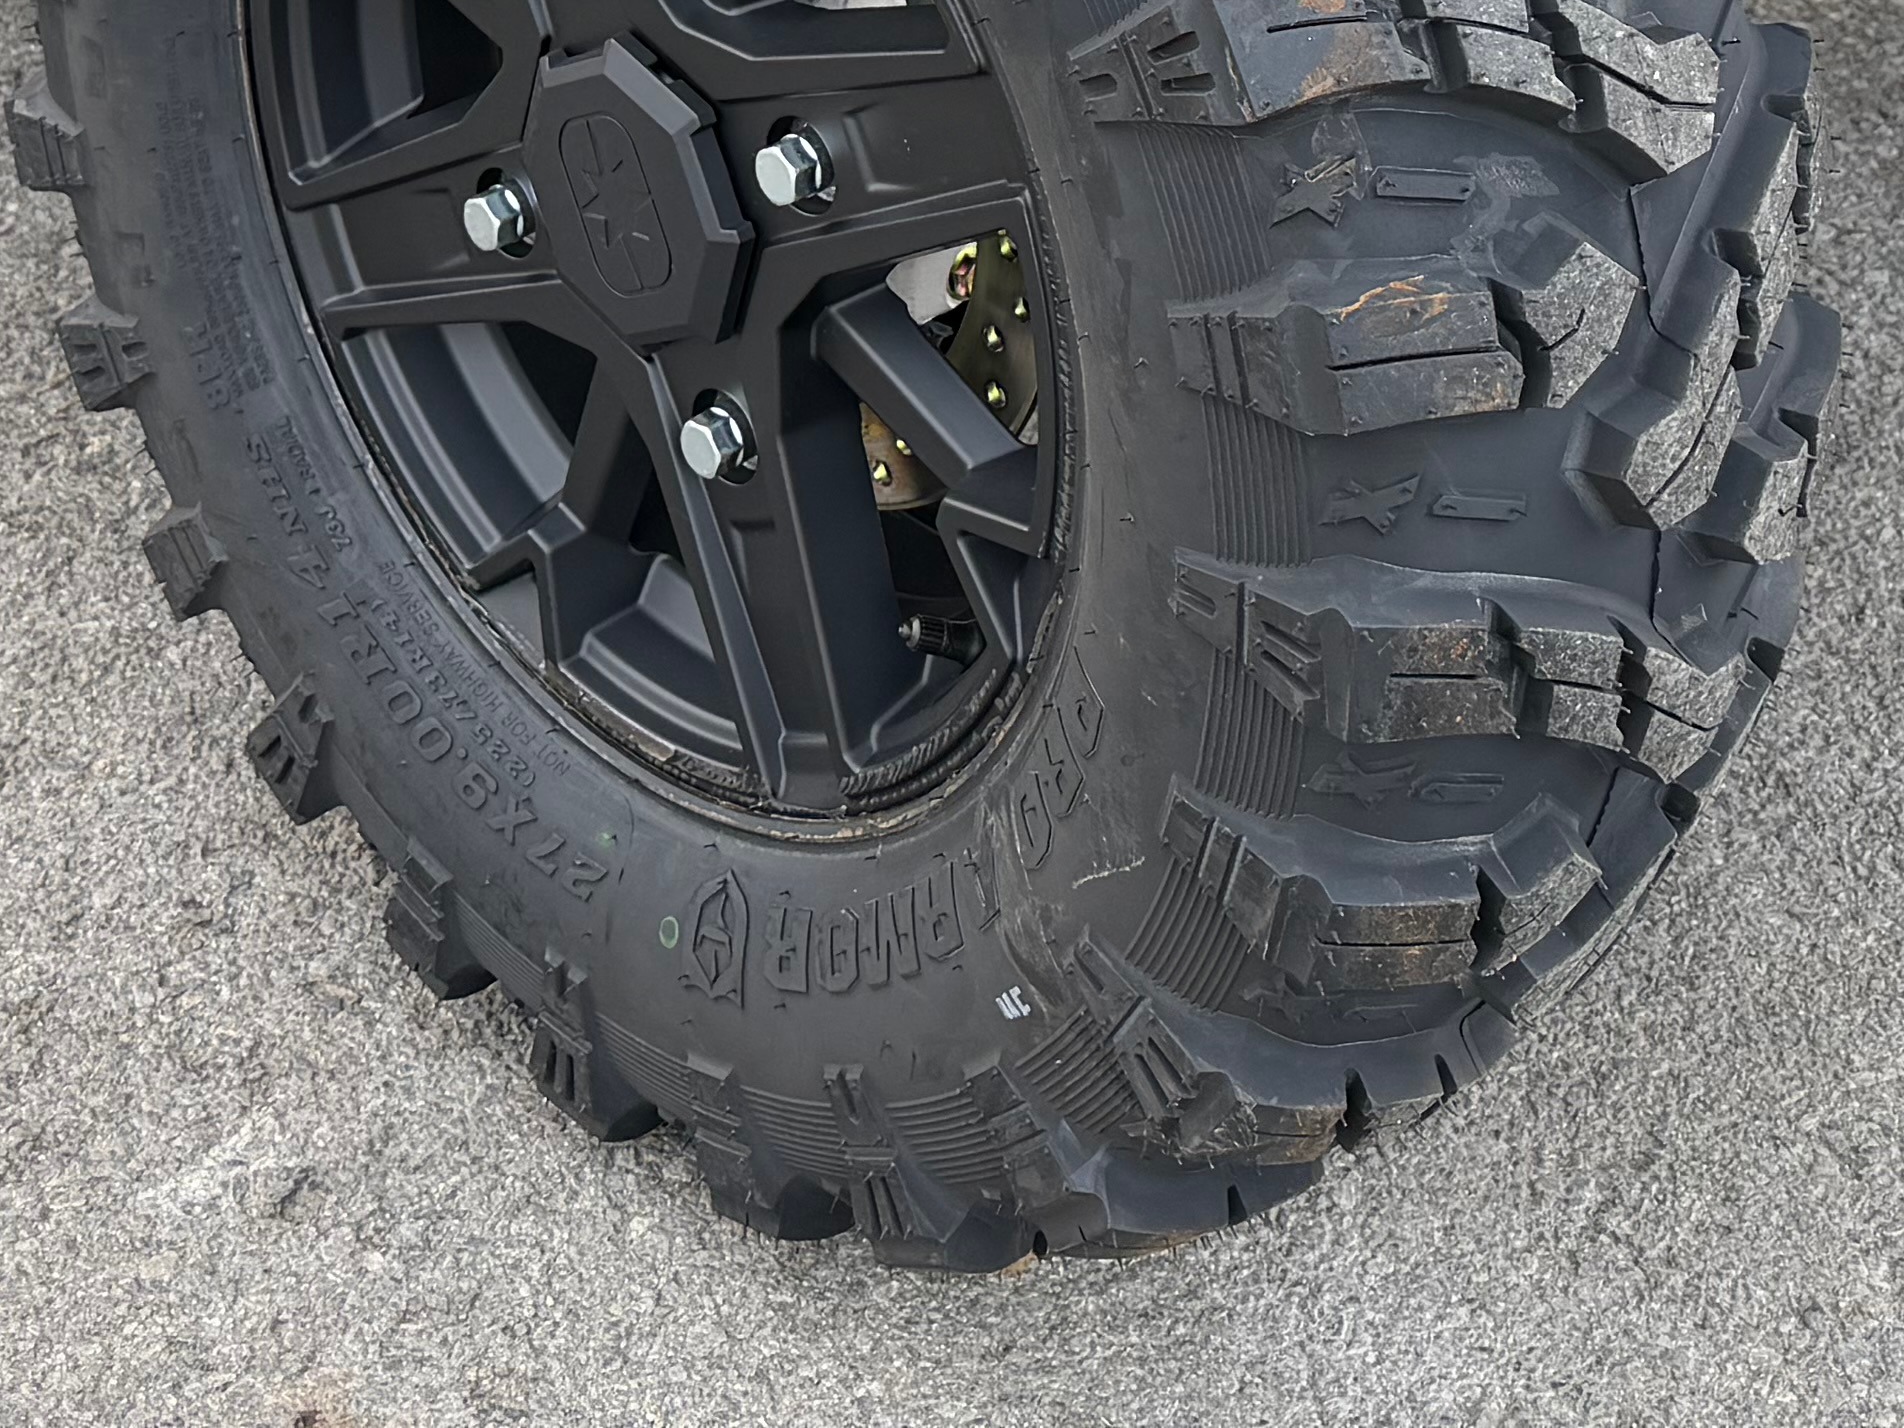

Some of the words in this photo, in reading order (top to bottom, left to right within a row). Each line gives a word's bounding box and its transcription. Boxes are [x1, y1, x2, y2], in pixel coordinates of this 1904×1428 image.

[371, 556, 446, 639] SERVICE
[434, 635, 505, 715] HIGHWAY
[498, 707, 538, 749] FOR
[531, 737, 573, 780] NOT
